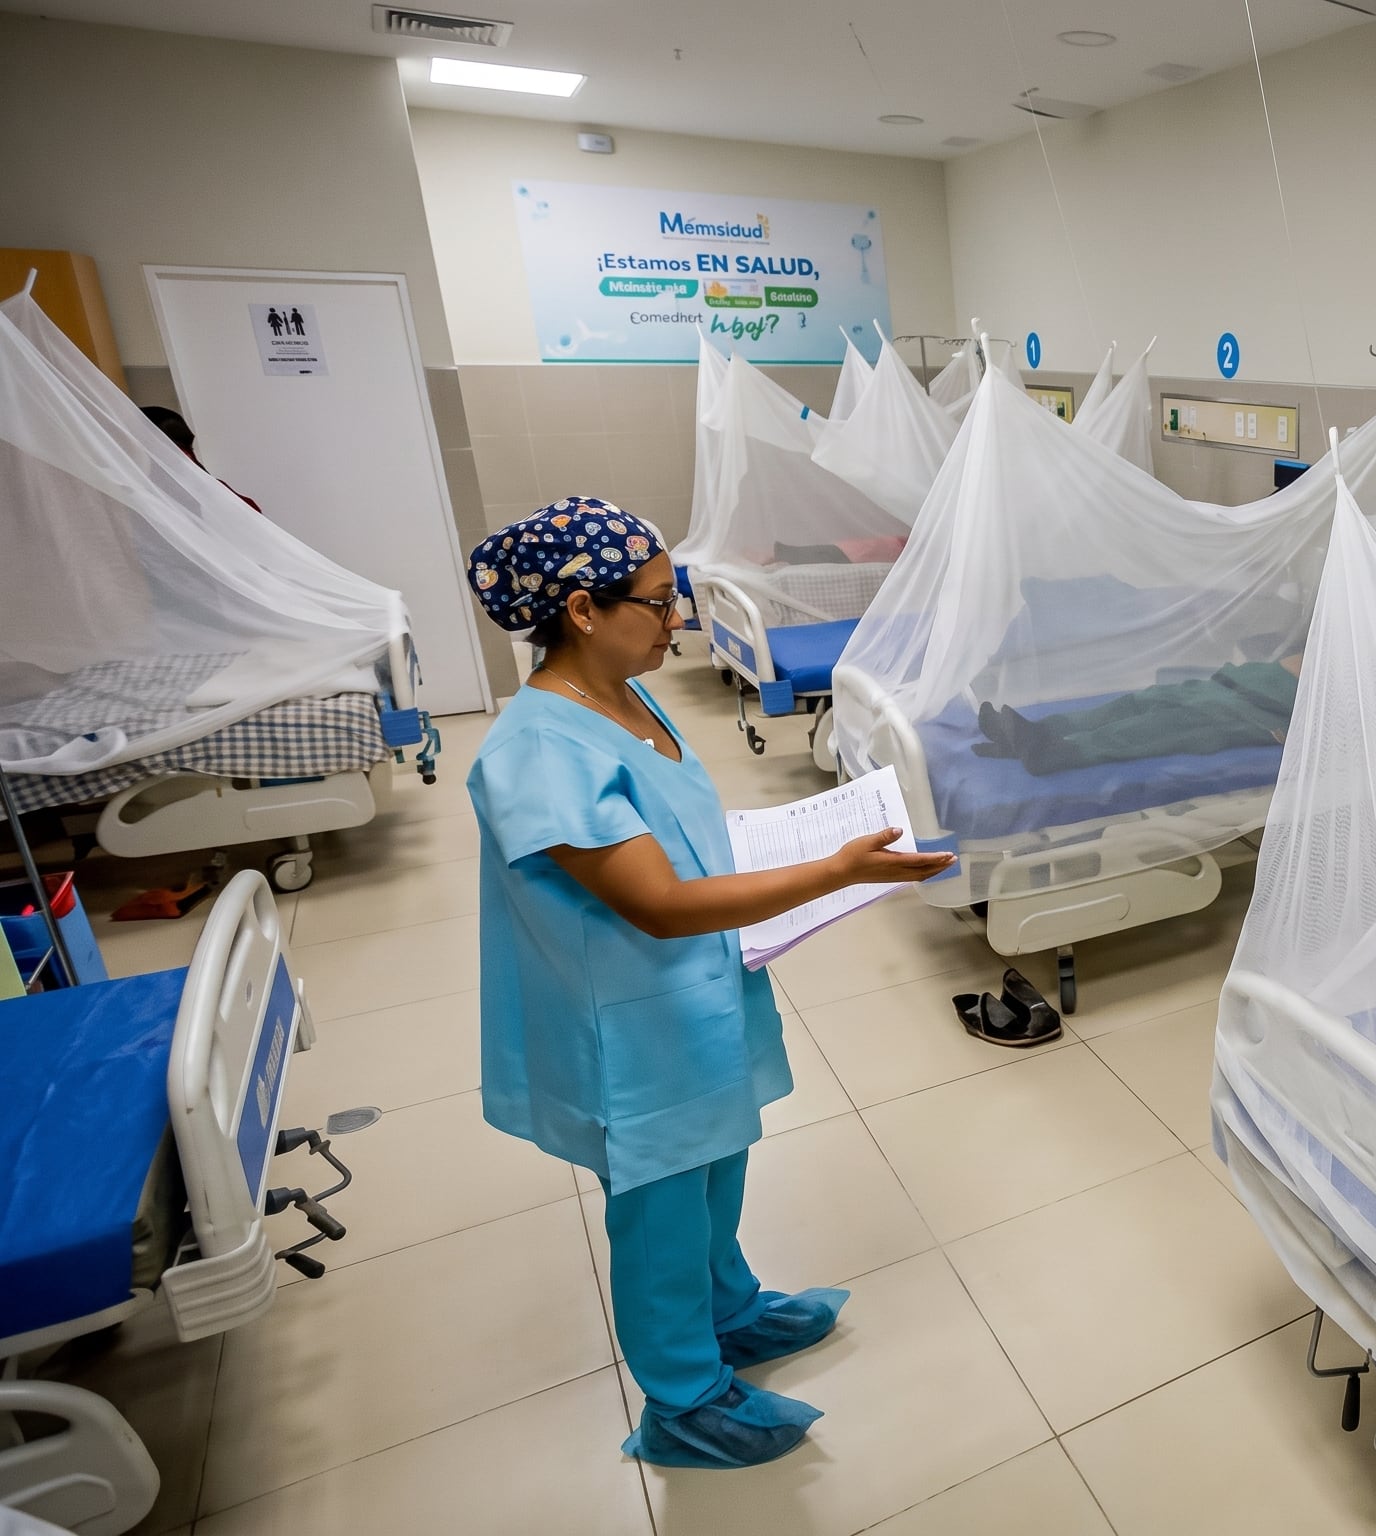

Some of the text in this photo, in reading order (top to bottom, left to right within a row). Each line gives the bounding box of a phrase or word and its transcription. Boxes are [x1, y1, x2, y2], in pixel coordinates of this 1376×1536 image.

[597, 253, 820, 280] ¡Estamos EN SALUD,
[1030, 340, 1036, 361] 1
[1222, 341, 1233, 368] 2
